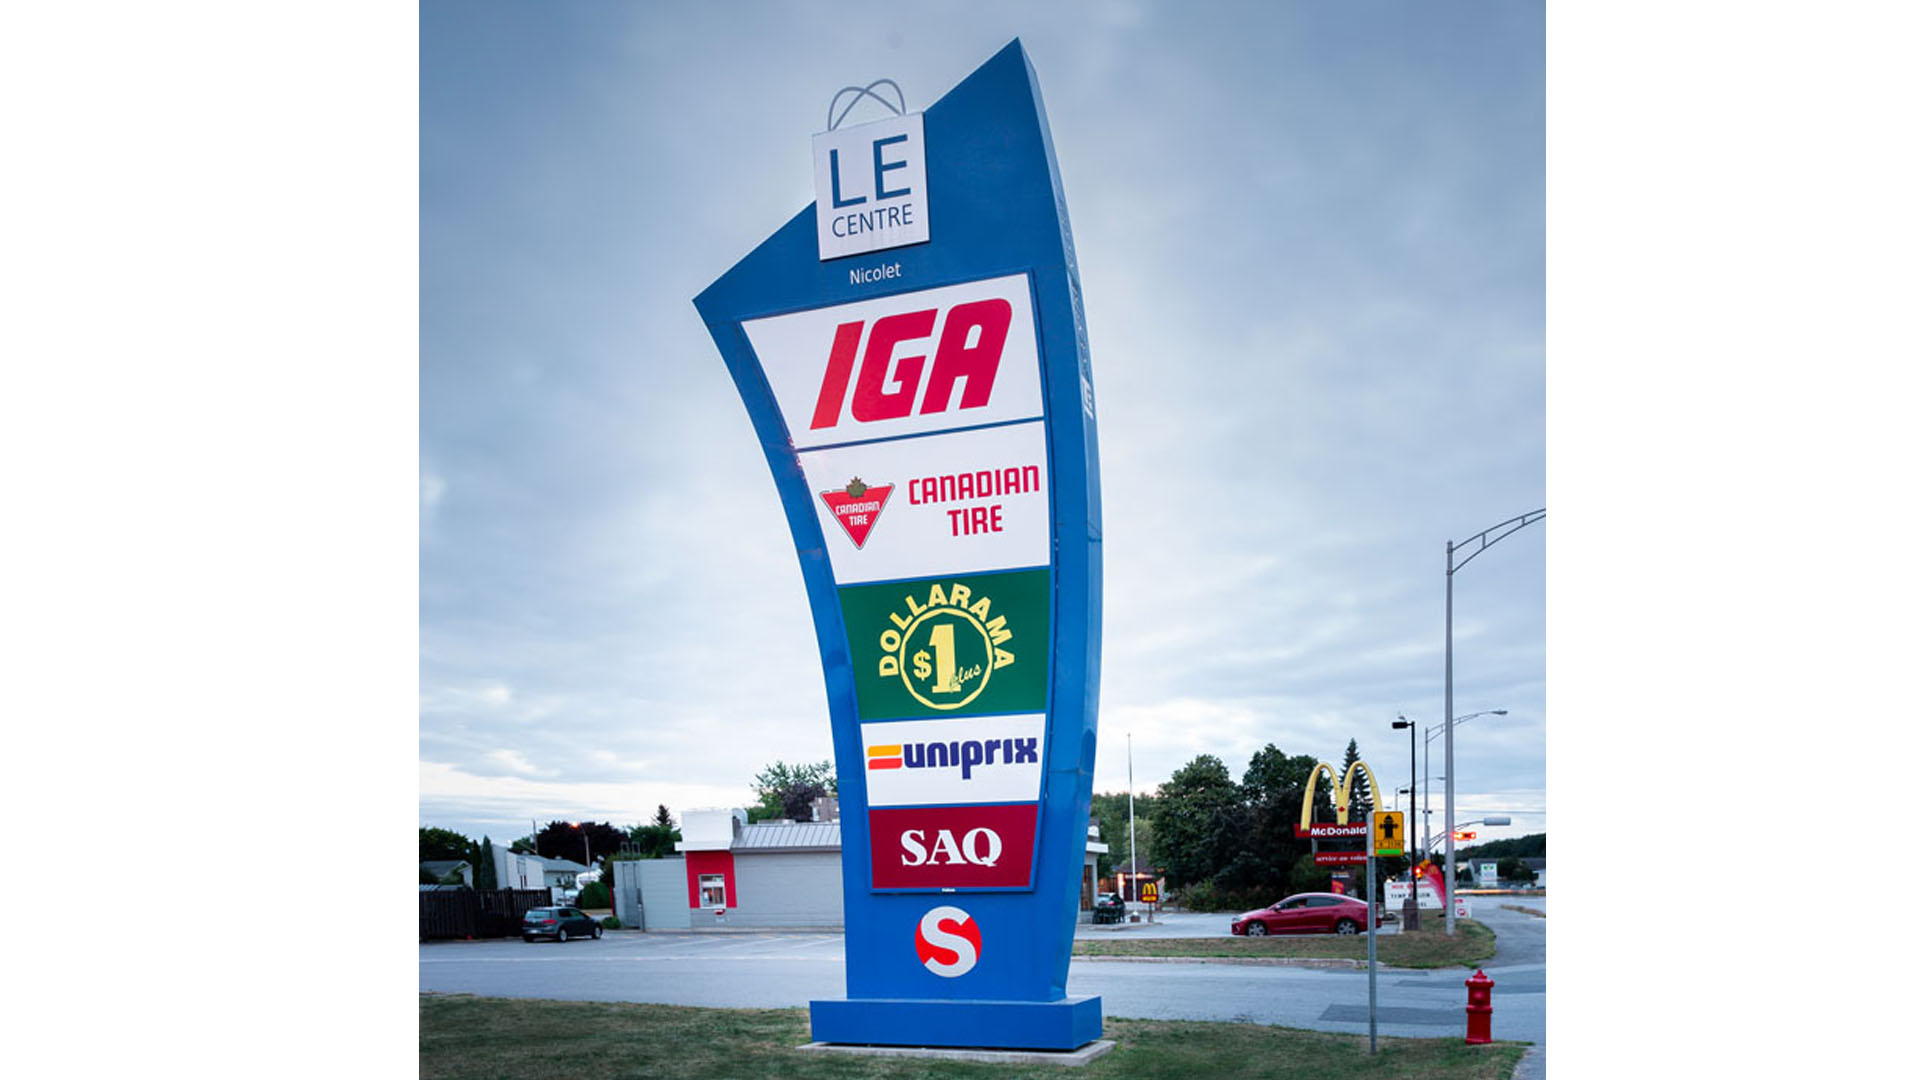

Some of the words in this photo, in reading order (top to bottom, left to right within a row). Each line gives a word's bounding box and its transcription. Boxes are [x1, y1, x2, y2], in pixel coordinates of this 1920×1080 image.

[830, 134, 911, 209] LE
[832, 203, 913, 238] CENTRE
[850, 262, 902, 285] Nicolet
[810, 298, 1012, 430] IGA
[909, 465, 1040, 505] CANADIAN
[836, 501, 880, 515] CANADIAN
[849, 514, 868, 526] TIRE
[947, 505, 1003, 536] TIRE
[879, 583, 1015, 677] DOLLARAMA
[913, 624, 961, 693] $1
[901, 827, 1003, 867] SAQ
[1311, 826, 1367, 836] McDonald
